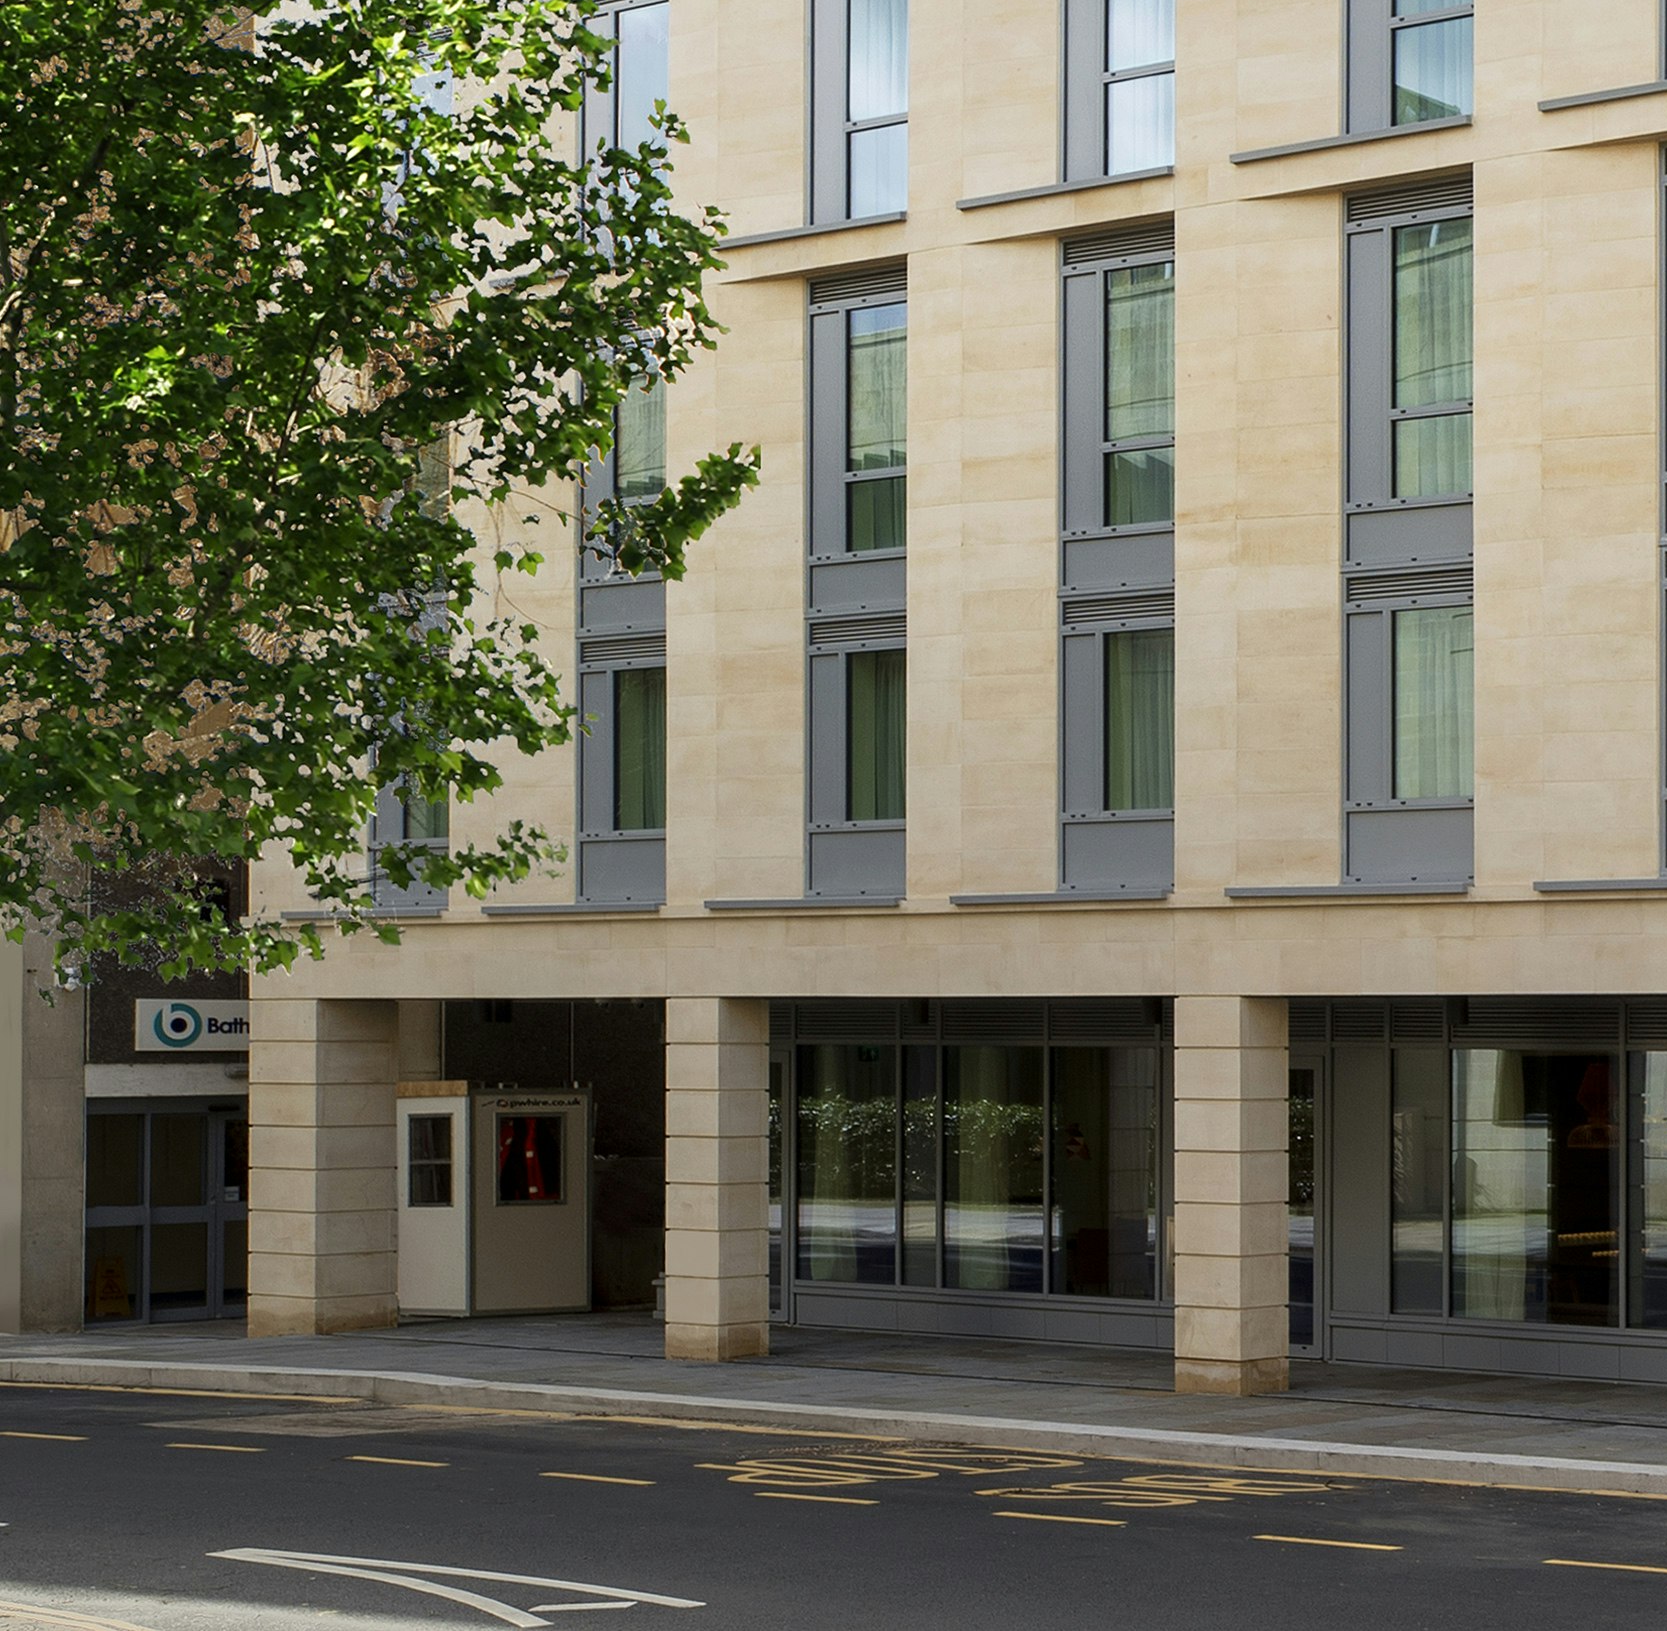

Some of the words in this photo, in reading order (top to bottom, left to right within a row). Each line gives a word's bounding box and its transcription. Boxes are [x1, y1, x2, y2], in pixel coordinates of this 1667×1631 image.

[207, 1017, 250, 1034] Bath
[693, 1448, 1084, 1486] STOP
[973, 1474, 1355, 1507] BUS
